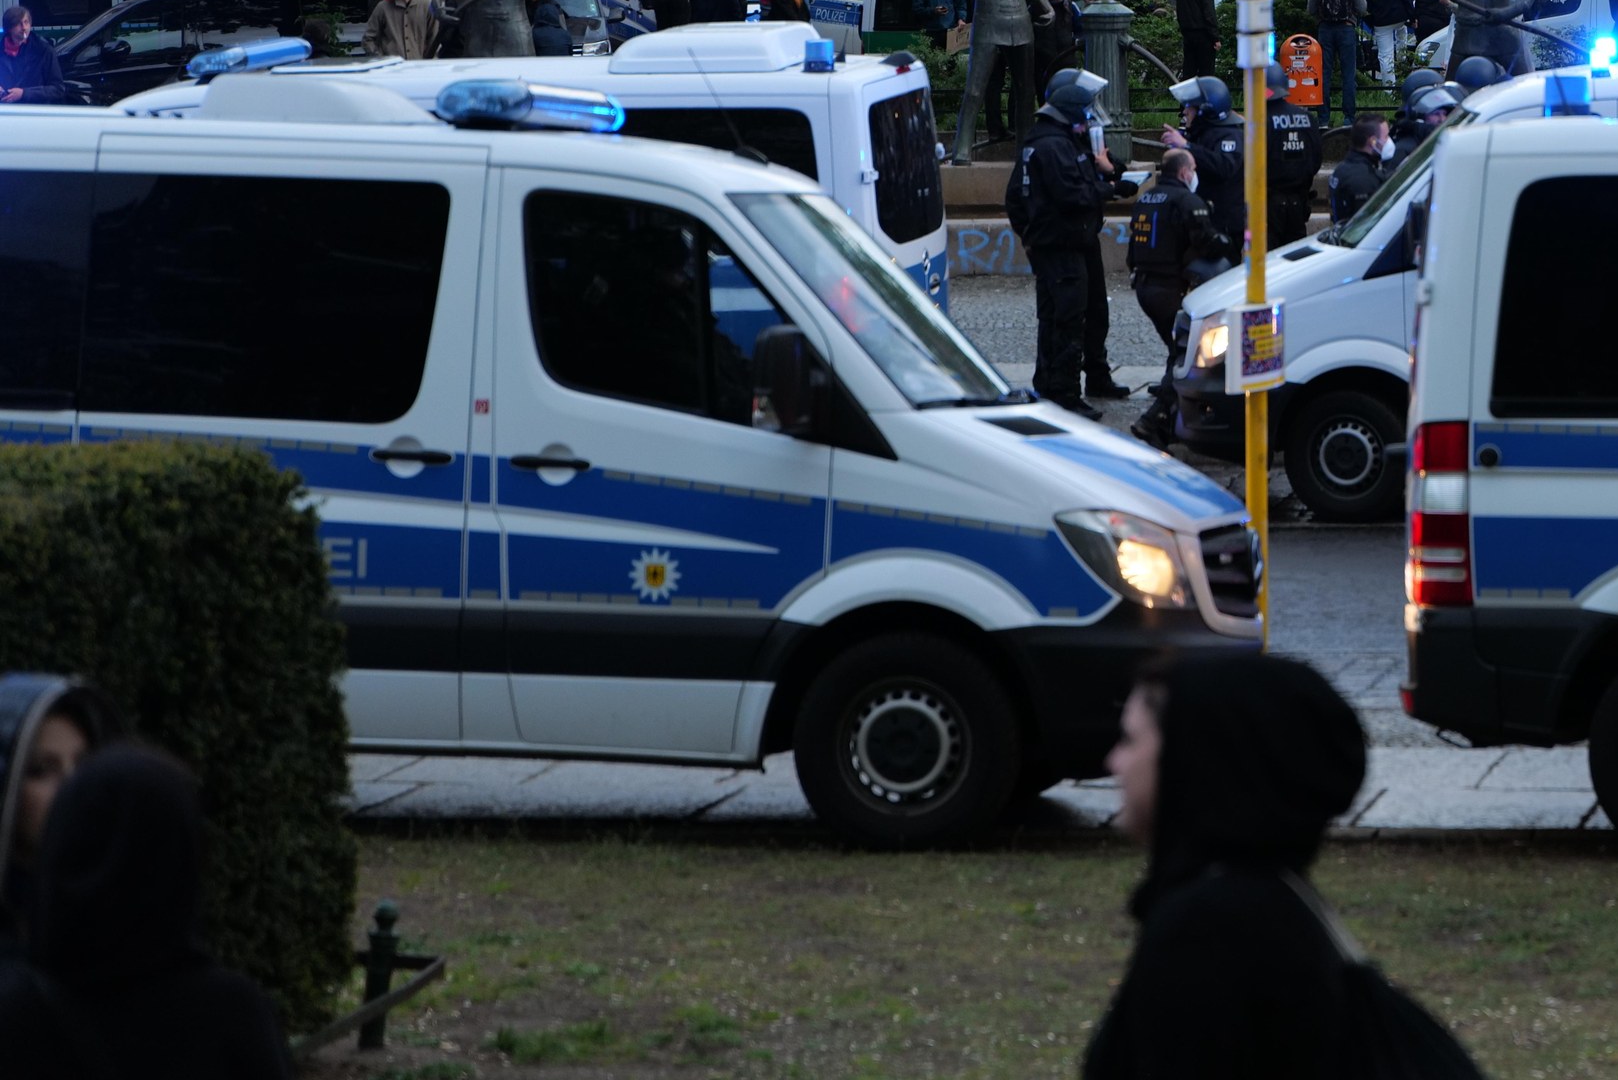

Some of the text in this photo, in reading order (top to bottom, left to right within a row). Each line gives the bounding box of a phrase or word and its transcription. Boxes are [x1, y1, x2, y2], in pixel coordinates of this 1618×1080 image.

[815, 8, 848, 22] POLIZEI
[1272, 114, 1311, 129] POLIZEI
[1283, 141, 1304, 151] 24314
